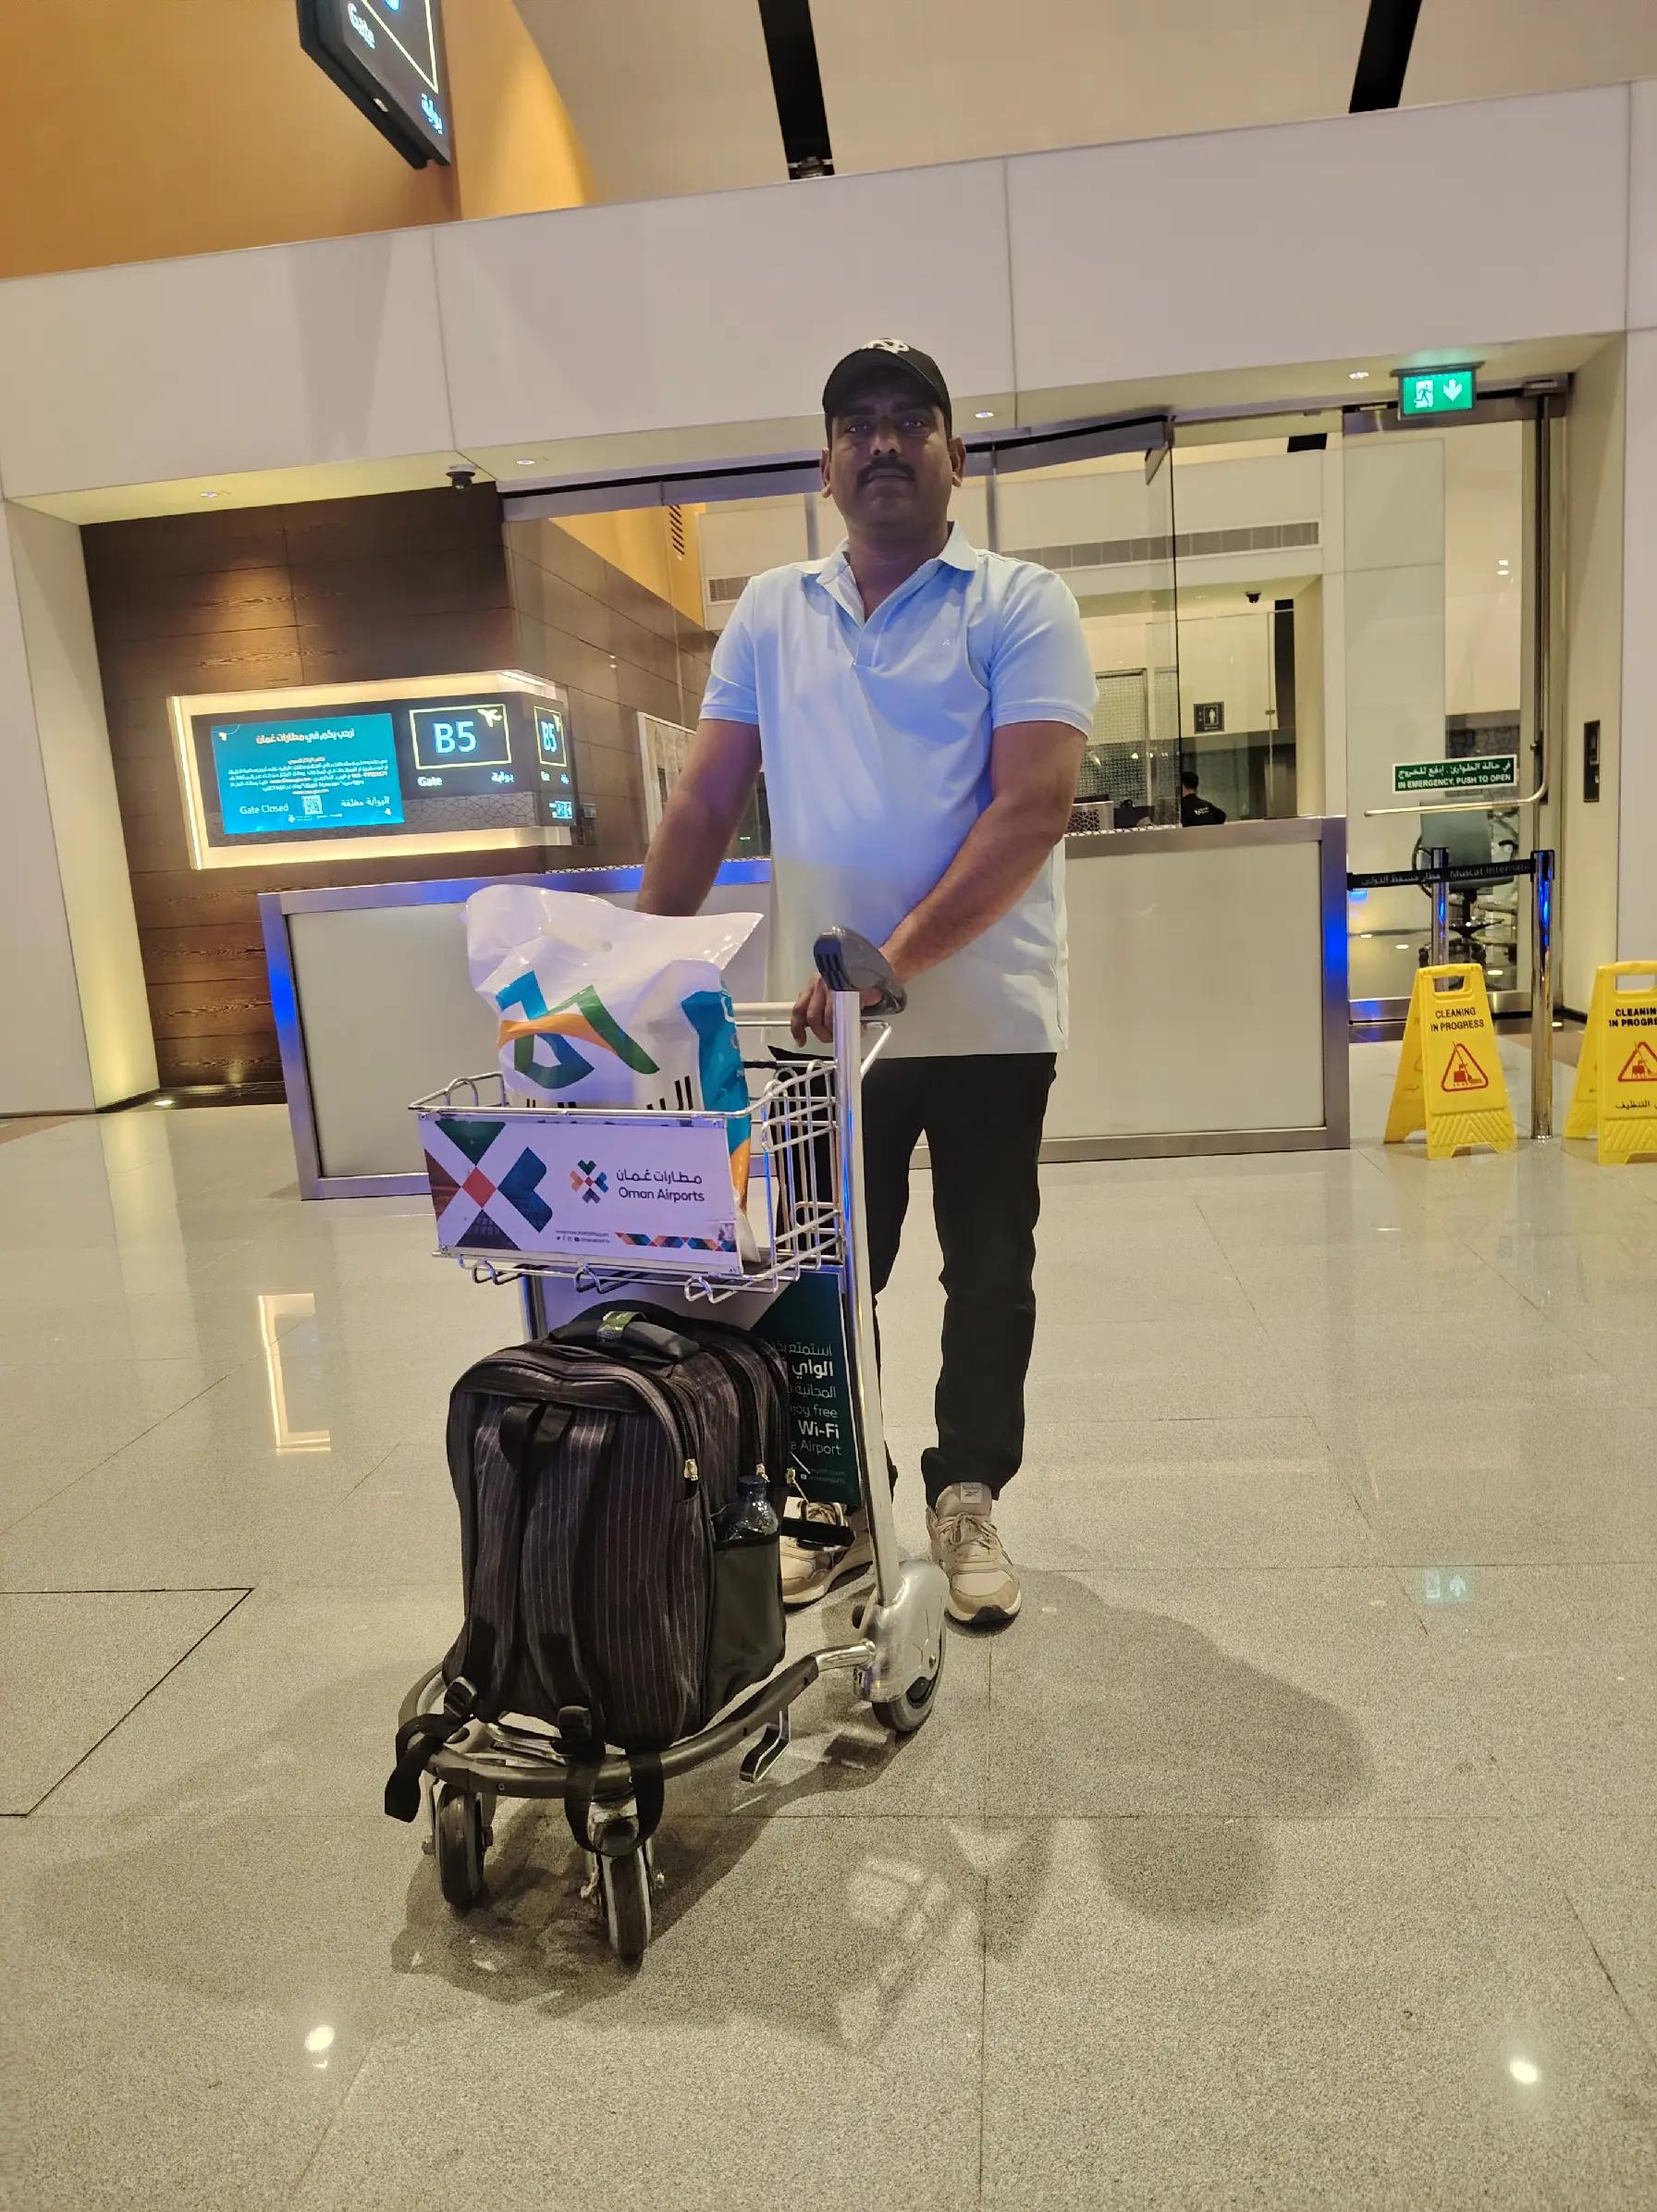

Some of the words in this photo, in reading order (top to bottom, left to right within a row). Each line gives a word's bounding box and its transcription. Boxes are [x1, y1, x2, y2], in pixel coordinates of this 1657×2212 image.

[347, 4, 375, 49] Gate
[434, 720, 477, 754] B5
[541, 721, 557, 752] B5
[418, 776, 443, 787] Gate
[1456, 777, 1477, 785] PUSH
[1479, 775, 1489, 783] TO
[1491, 773, 1511, 782] OPEN
[239, 805, 260, 814] Gate
[262, 803, 288, 813] Closed
[1450, 868, 1483, 879] Muscat
[1435, 1007, 1476, 1019] CLEANING
[1430, 1024, 1439, 1032] IN
[1441, 1019, 1484, 1031] PROGRESS
[653, 1171, 703, 1185] مطارات
[619, 1186, 655, 1199] Oman
[657, 1188, 705, 1203] Airports
[792, 1358, 834, 1380] الواي
[795, 1383, 837, 1399] المجانية
[814, 1404, 838, 1419] free
[798, 1419, 840, 1440] Wi-Fi
[801, 1440, 841, 1456] Airport
